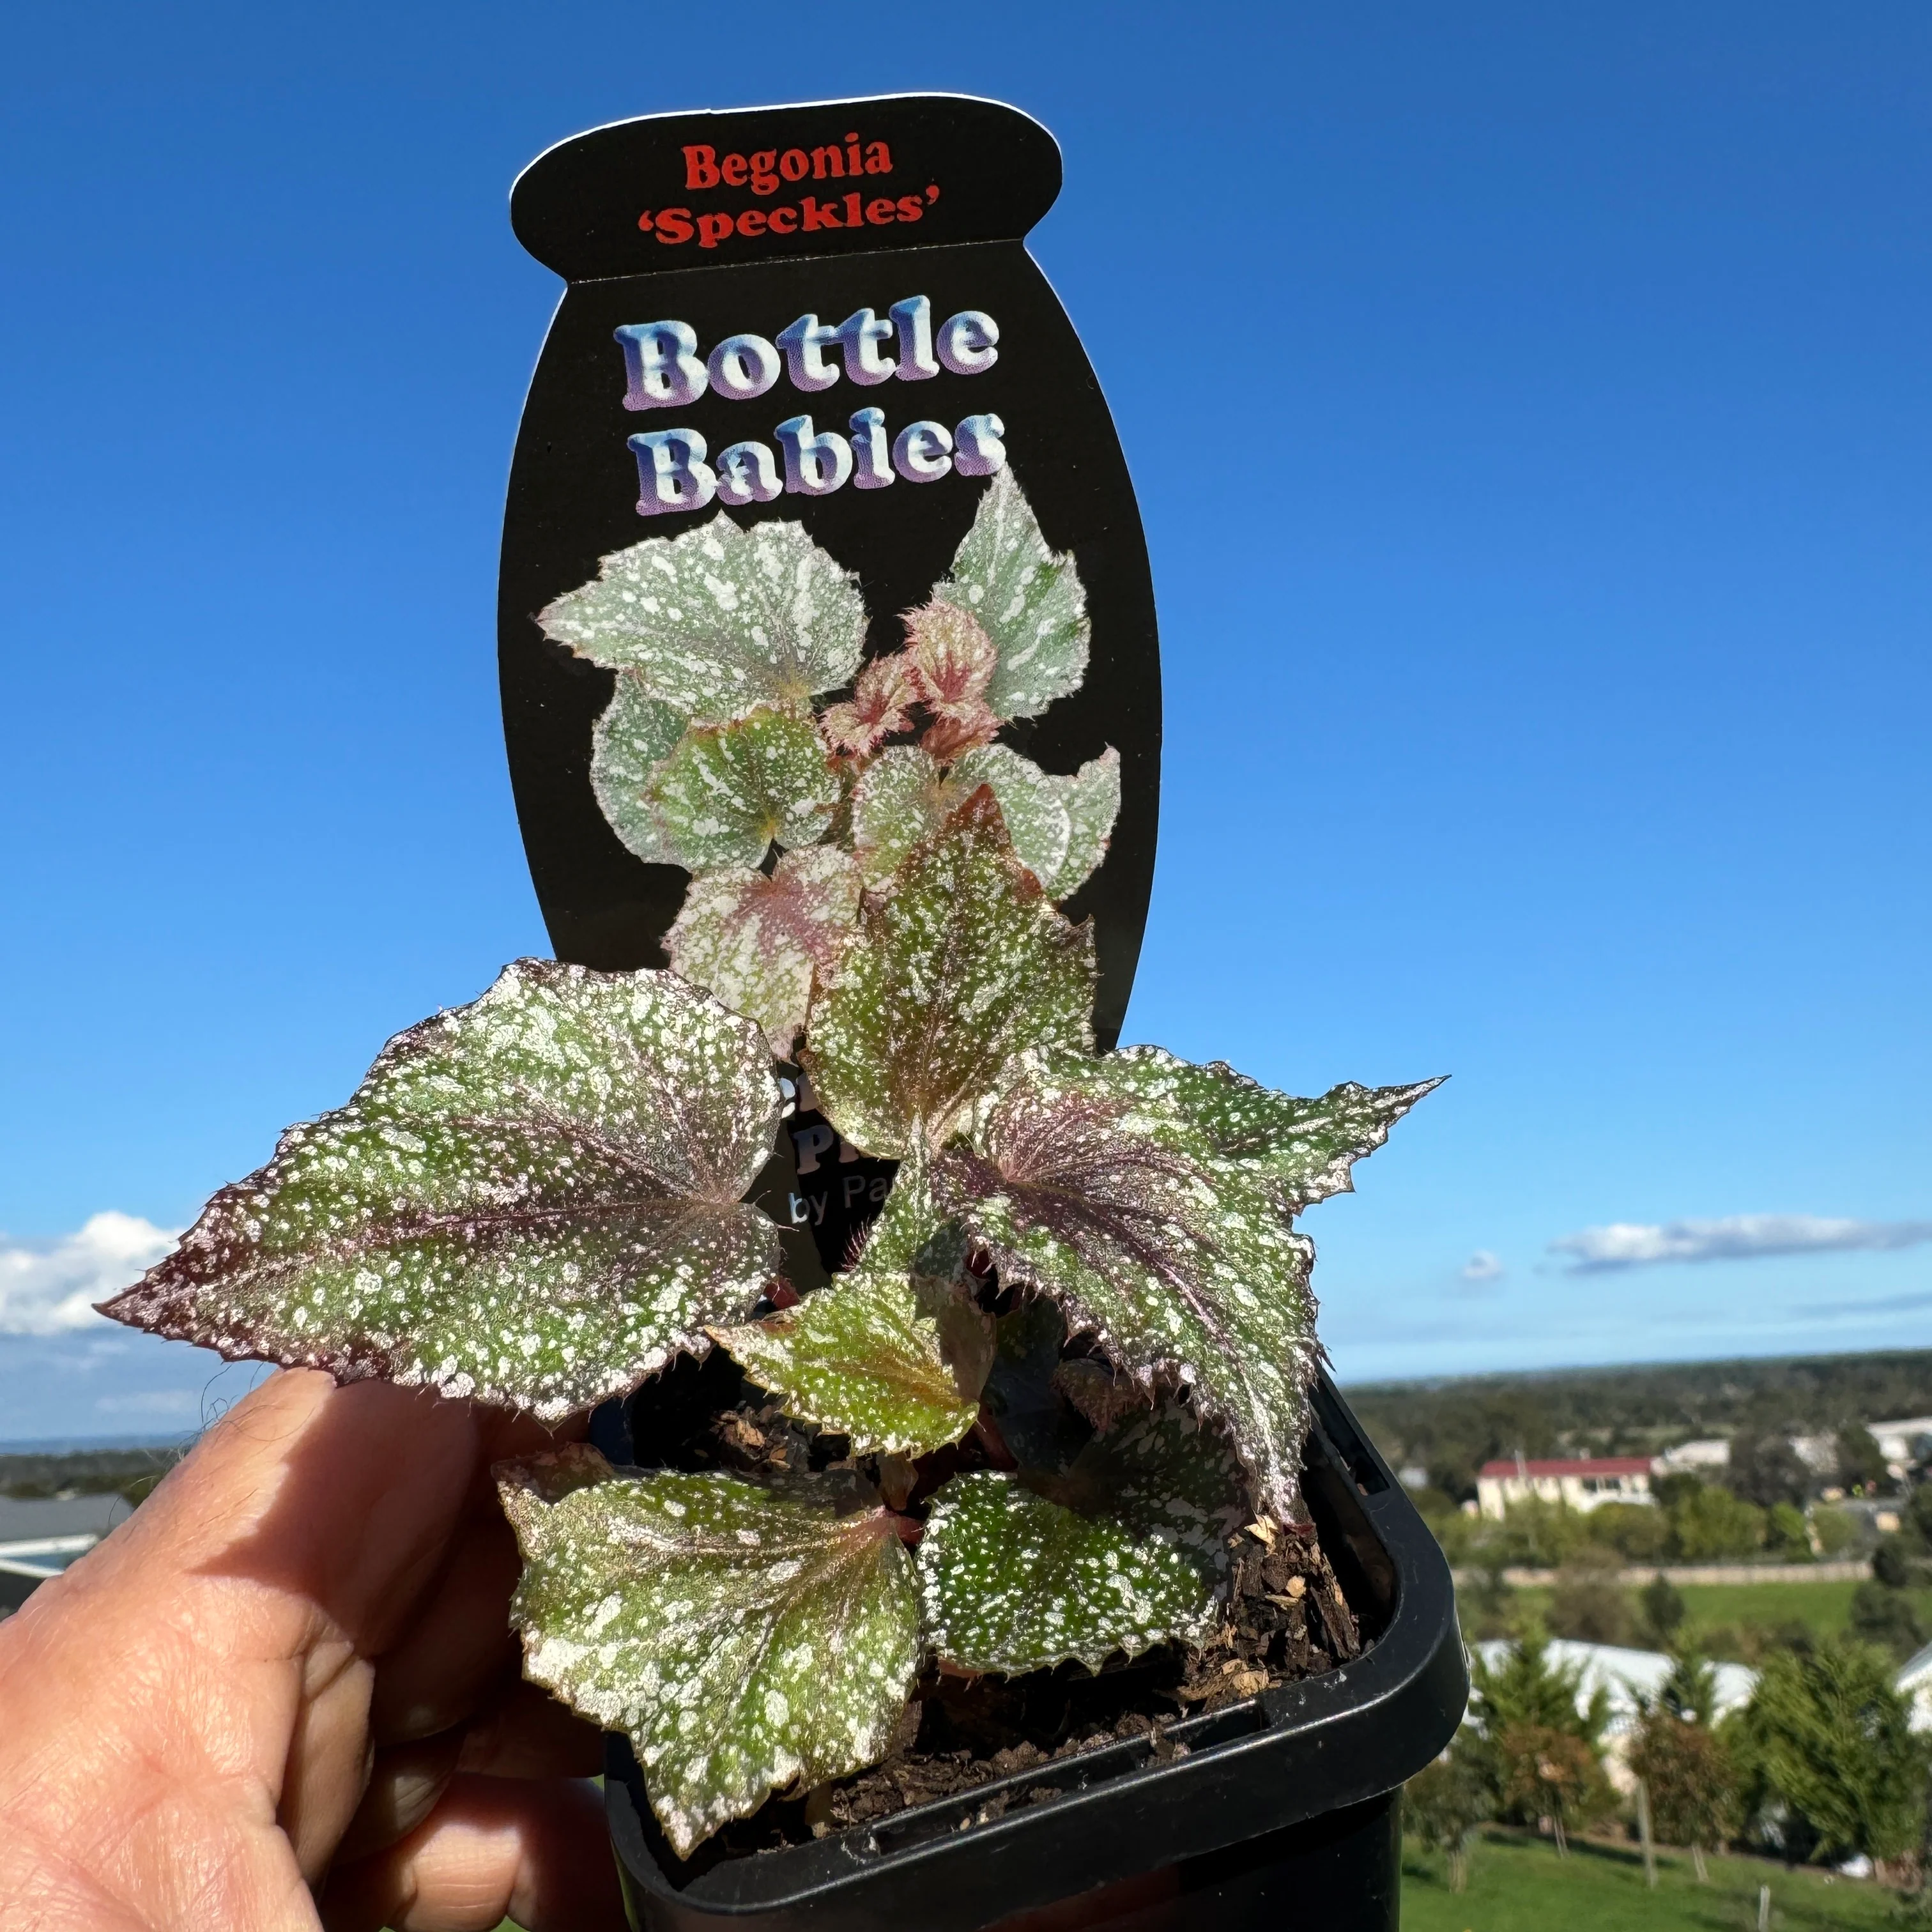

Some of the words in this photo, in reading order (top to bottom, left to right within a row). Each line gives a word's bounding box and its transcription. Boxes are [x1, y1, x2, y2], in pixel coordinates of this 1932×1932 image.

[682, 132, 893, 195] Begonia
[638, 185, 940, 248] ‘Speckles’
[613, 295, 1000, 411] Bottle
[627, 406, 1006, 516] Babies
[788, 1192, 828, 1225] by
